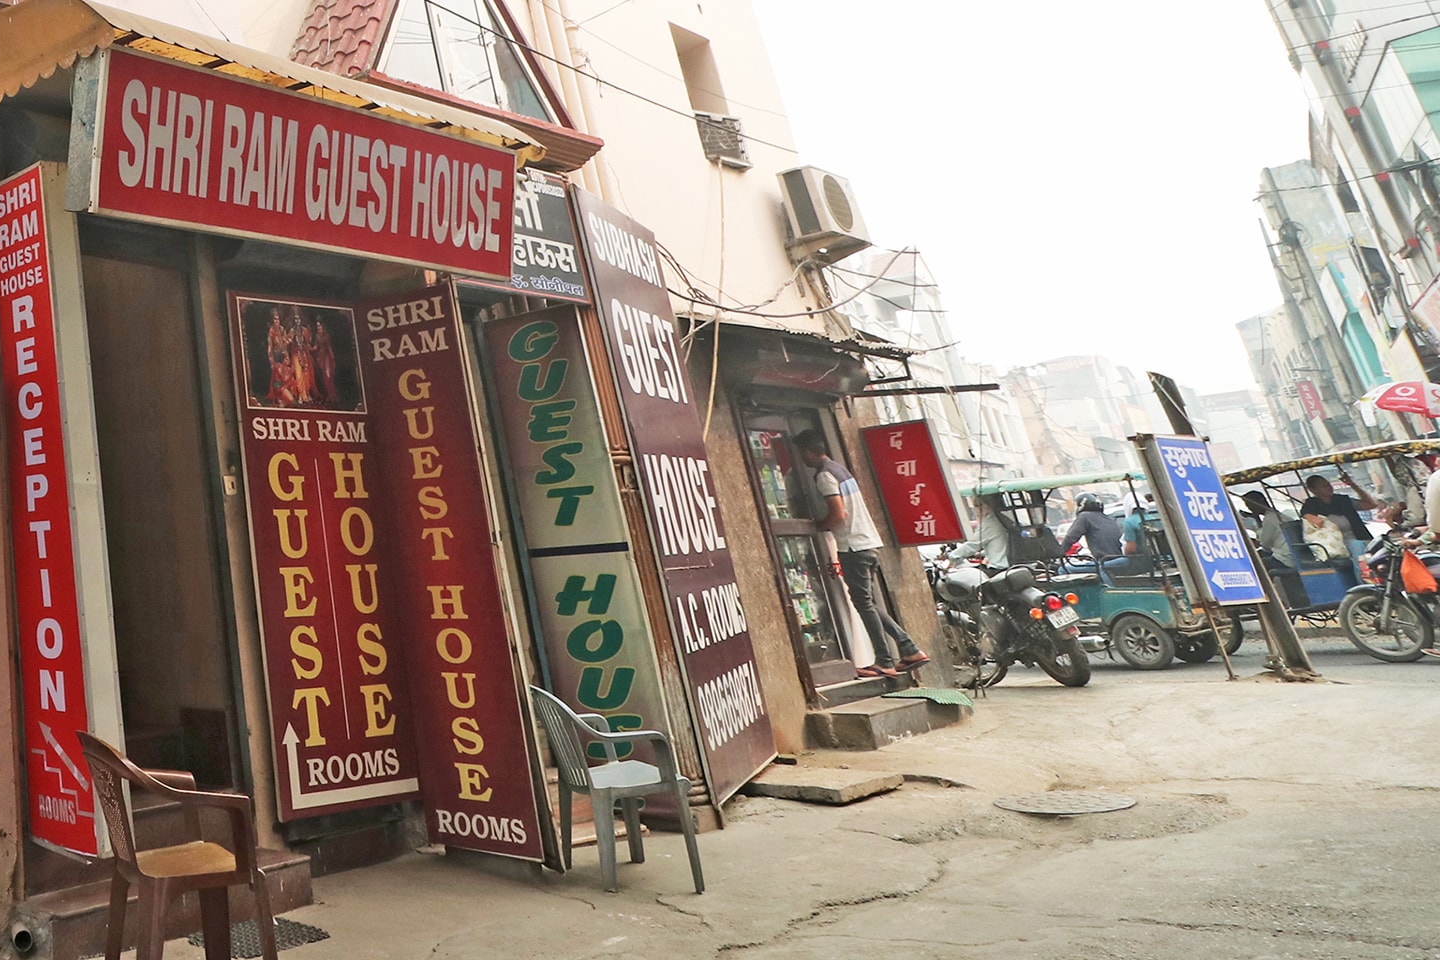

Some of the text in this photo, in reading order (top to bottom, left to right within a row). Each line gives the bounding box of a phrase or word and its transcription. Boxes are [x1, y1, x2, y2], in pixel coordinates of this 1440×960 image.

[117, 78, 214, 198] SHRI
[219, 104, 299, 215] RAM
[307, 123, 408, 234] GUEST
[410, 148, 501, 254] HOUSE
[0, 265, 44, 297] HOUSE
[588, 210, 662, 289] SUBHASH
[366, 295, 446, 332] SHRI
[370, 326, 450, 362] RAM
[610, 297, 689, 405] GUEST
[251, 416, 368, 443] SHRI RAM
[506, 319, 595, 528] GUEST
[1160, 445, 1212, 479] सुभाष
[11, 294, 68, 714] RECEPTION
[398, 368, 455, 562] GUEST
[642, 452, 727, 557] HOUSE
[1183, 479, 1225, 523] गेस्ट
[1190, 529, 1245, 563] हाऊस
[267, 450, 332, 748] GUEST
[328, 451, 398, 739] HOUSE
[675, 581, 748, 655] A.C. ROOMS
[427, 584, 493, 803] HOUSE
[555, 571, 645, 810] HOUS
[696, 659, 766, 752] 9896698874
[305, 748, 401, 788] ROOMS
[38, 794, 77, 825] ROOMS
[436, 807, 528, 846] ROOMS
